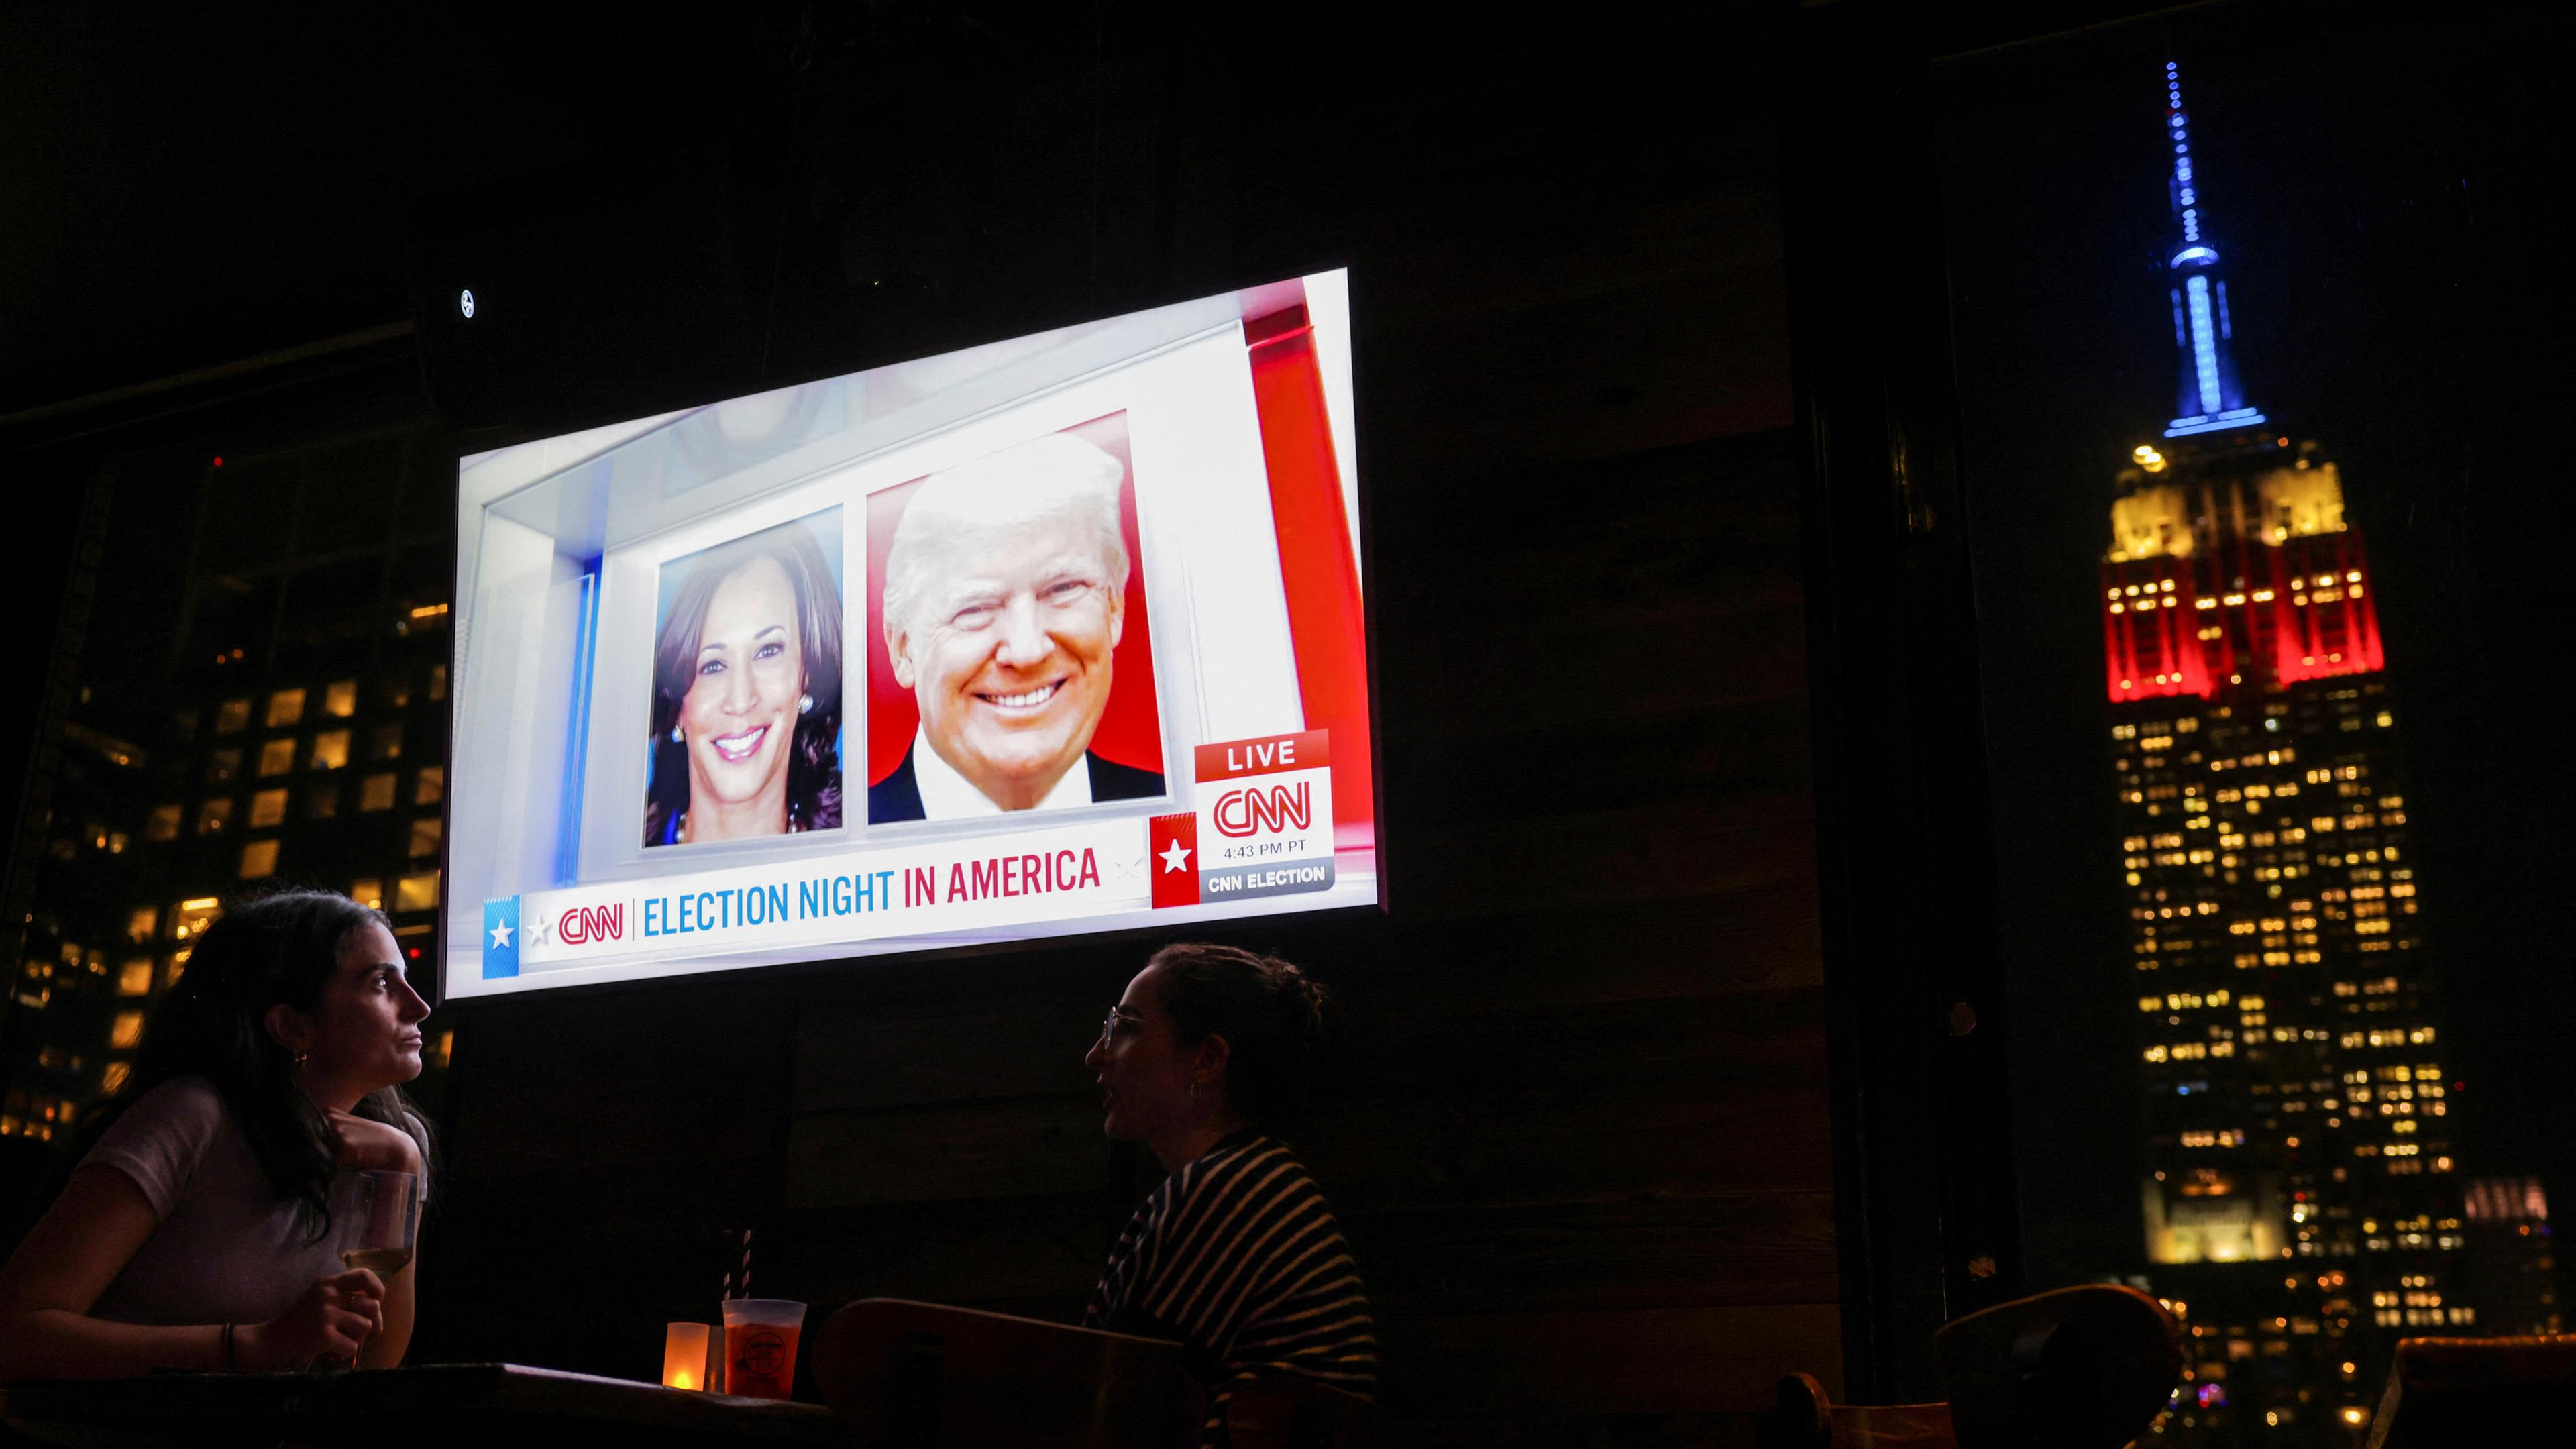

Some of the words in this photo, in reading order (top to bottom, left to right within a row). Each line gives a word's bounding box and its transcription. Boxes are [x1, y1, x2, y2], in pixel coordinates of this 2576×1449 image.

[1228, 741, 1295, 771] LIVE
[1213, 781, 1311, 838] CNN
[1224, 845, 1254, 859] 4:43
[1260, 842, 1282, 855] PM
[1289, 839, 1306, 852] PT
[1208, 875, 1242, 893] CNN
[1247, 866, 1326, 889] ELECTION
[559, 903, 623, 945] CNN
[644, 883, 788, 937] ELECTION
[800, 871, 895, 920] NIGHT
[904, 866, 936, 908] IN
[947, 847, 1101, 903] AMERICA
